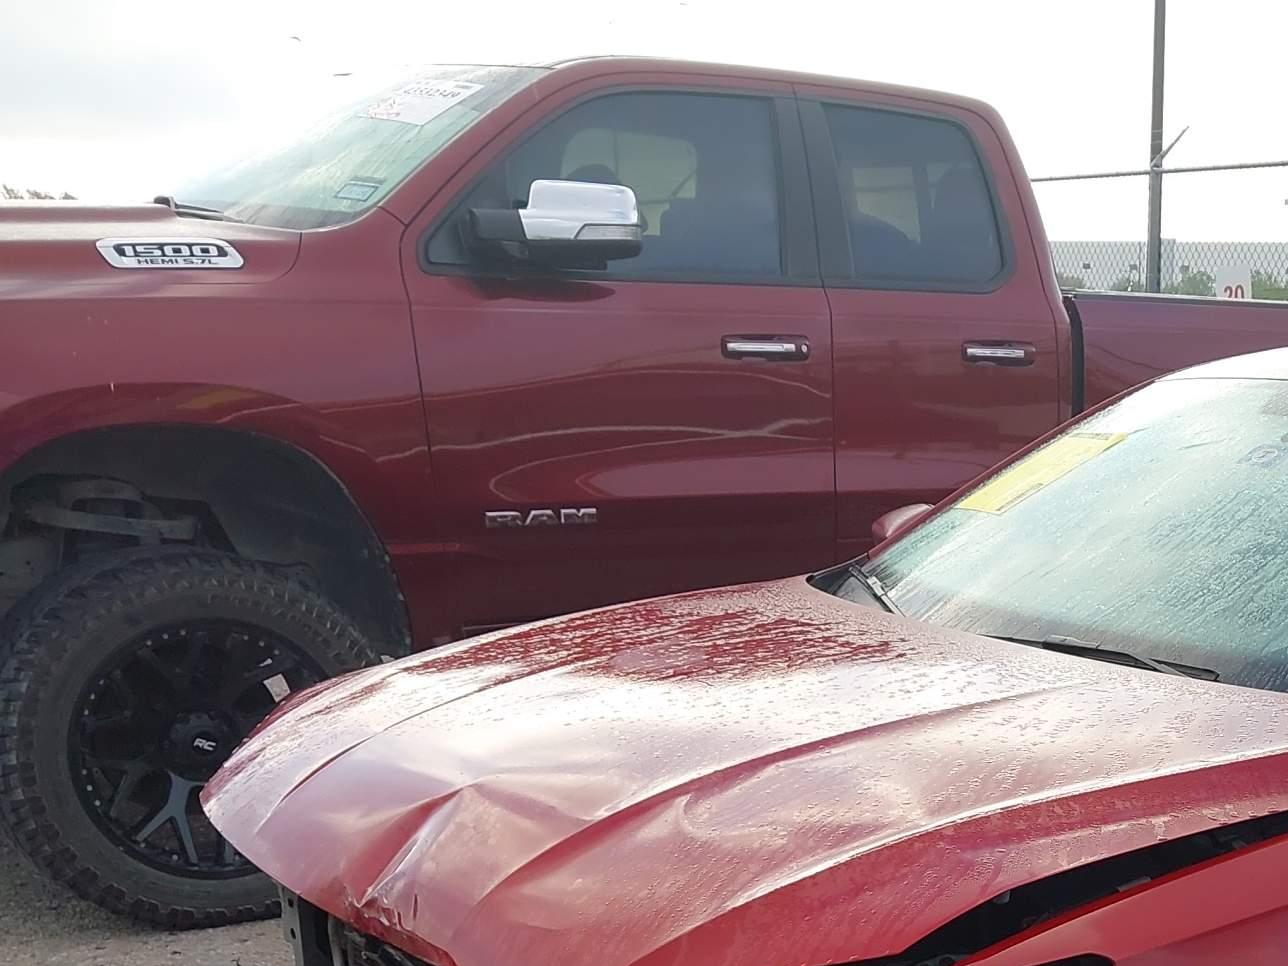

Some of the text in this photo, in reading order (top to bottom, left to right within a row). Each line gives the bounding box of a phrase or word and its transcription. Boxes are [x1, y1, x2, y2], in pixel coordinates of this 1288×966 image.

[119, 245, 219, 257] 1500
[137, 257, 219, 265] HEMI 5.7L
[1223, 284, 1245, 299] 20
[485, 508, 597, 528] RAM
[193, 737, 217, 751] RC
